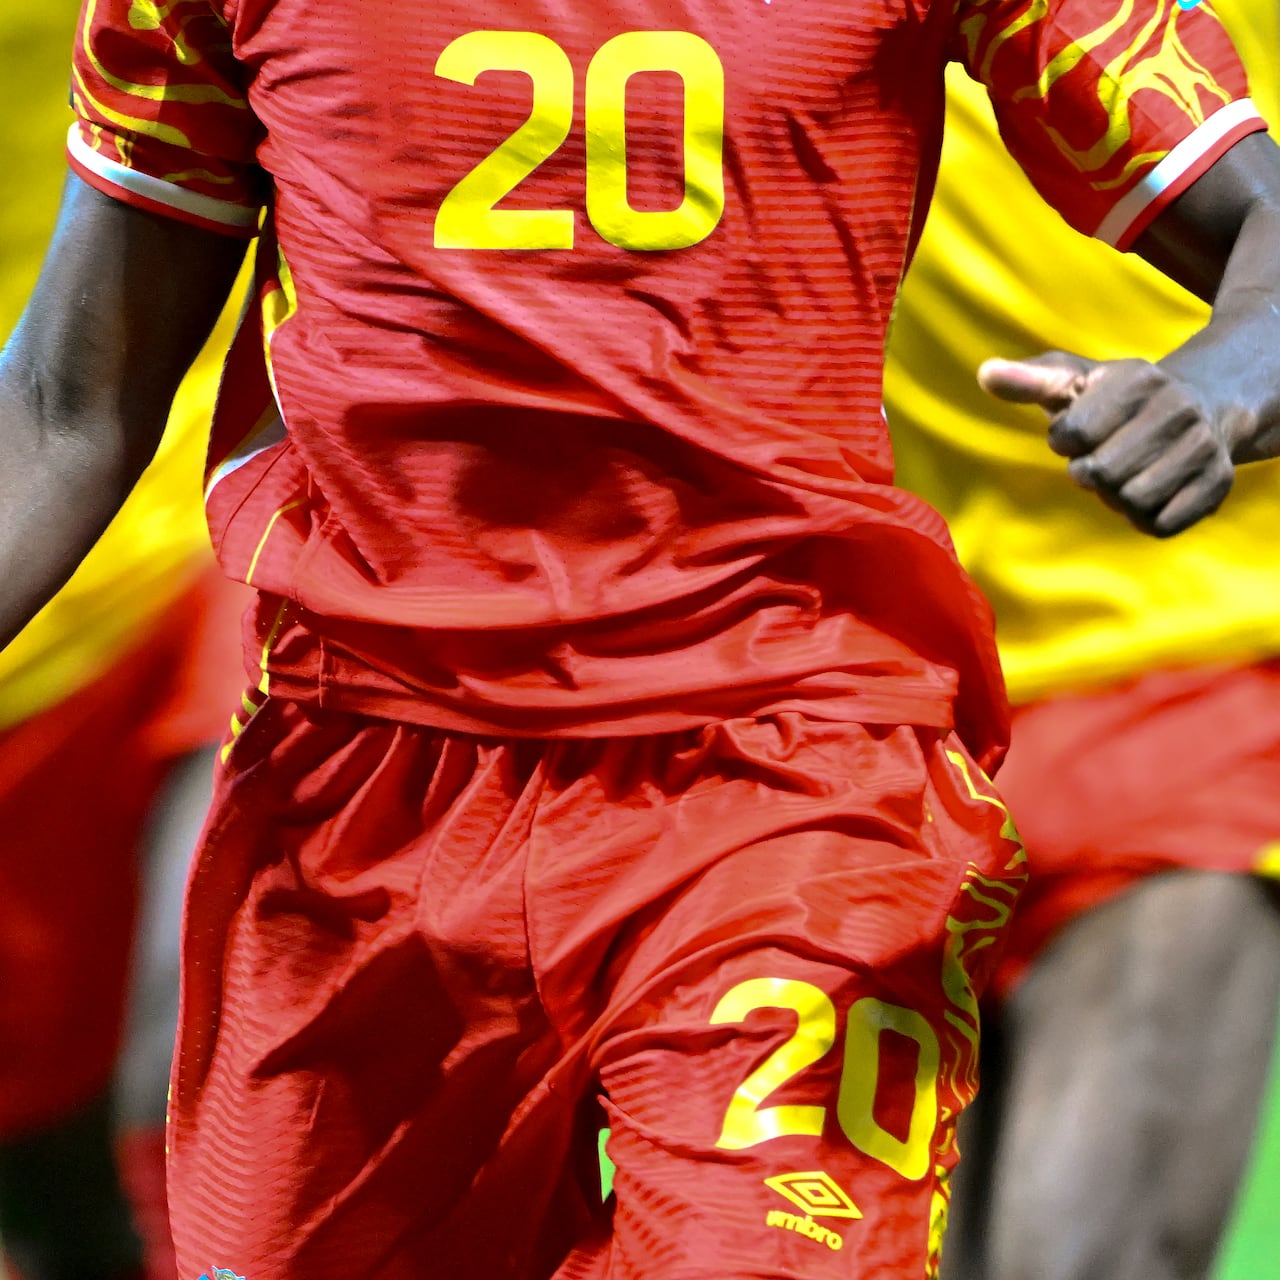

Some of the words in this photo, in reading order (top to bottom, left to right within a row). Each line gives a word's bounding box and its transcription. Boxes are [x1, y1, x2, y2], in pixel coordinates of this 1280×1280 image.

[434, 31, 725, 251] 20
[709, 977, 941, 1180] 20
[765, 1209, 843, 1250] umbro
